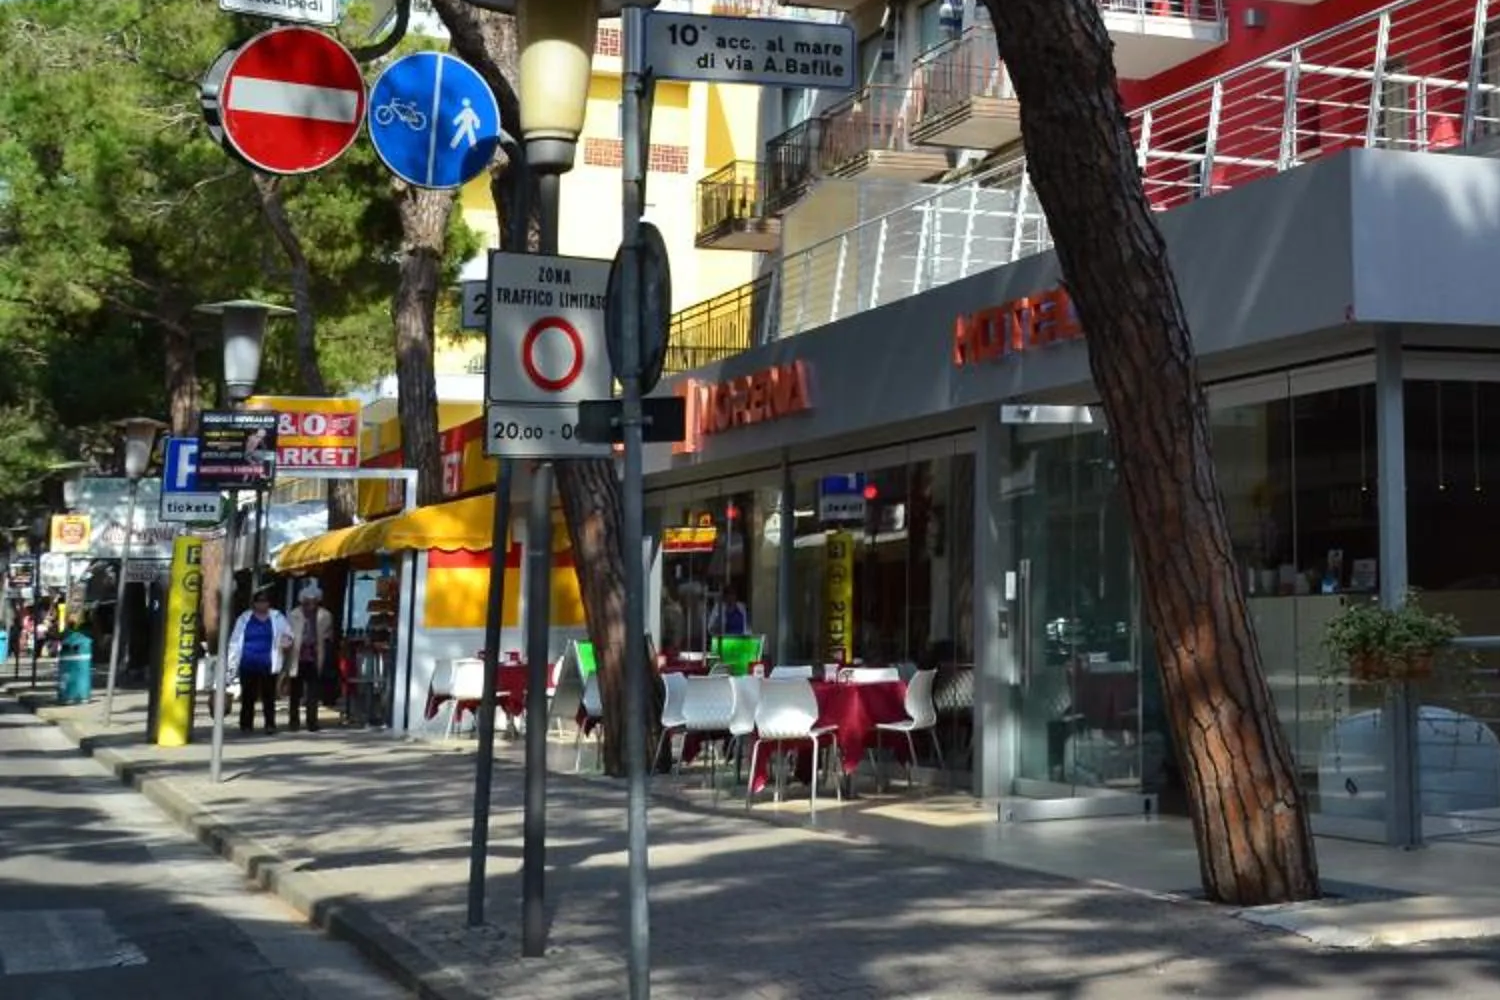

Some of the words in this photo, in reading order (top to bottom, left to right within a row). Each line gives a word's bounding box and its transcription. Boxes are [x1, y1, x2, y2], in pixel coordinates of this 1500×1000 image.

[715, 34, 757, 51] acc.
[766, 35, 784, 52] al
[794, 43, 844, 57] mare
[696, 52, 716, 69] di
[723, 53, 754, 72] via
[763, 55, 845, 78] A.Bafile
[537, 265, 572, 285] ZONA
[495, 286, 554, 308] TRAFFICO
[166, 502, 216, 514] tickets
[176, 611, 197, 699] TICKETS
